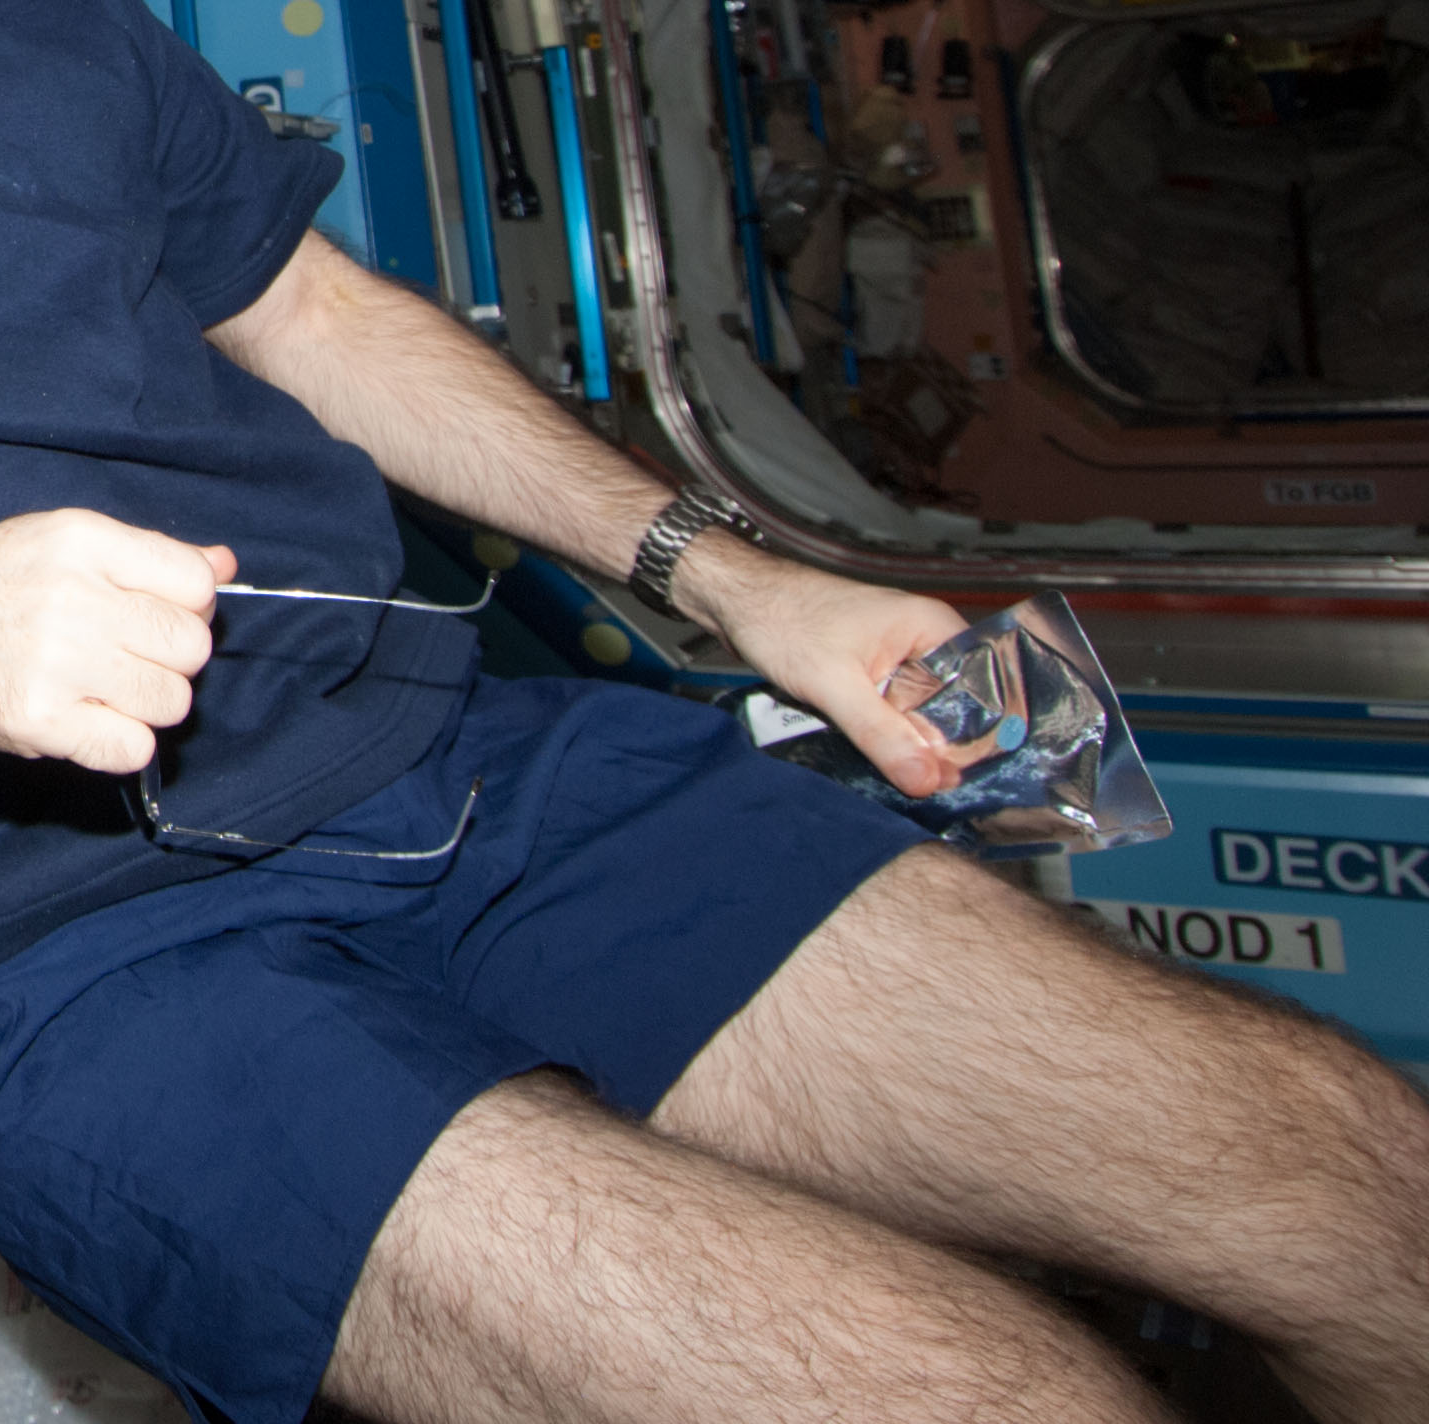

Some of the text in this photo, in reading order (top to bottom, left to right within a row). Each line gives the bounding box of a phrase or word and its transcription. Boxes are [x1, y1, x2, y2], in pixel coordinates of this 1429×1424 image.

[1221, 833, 1429, 897] DECK
[1130, 906, 1325, 969] NOD 1
